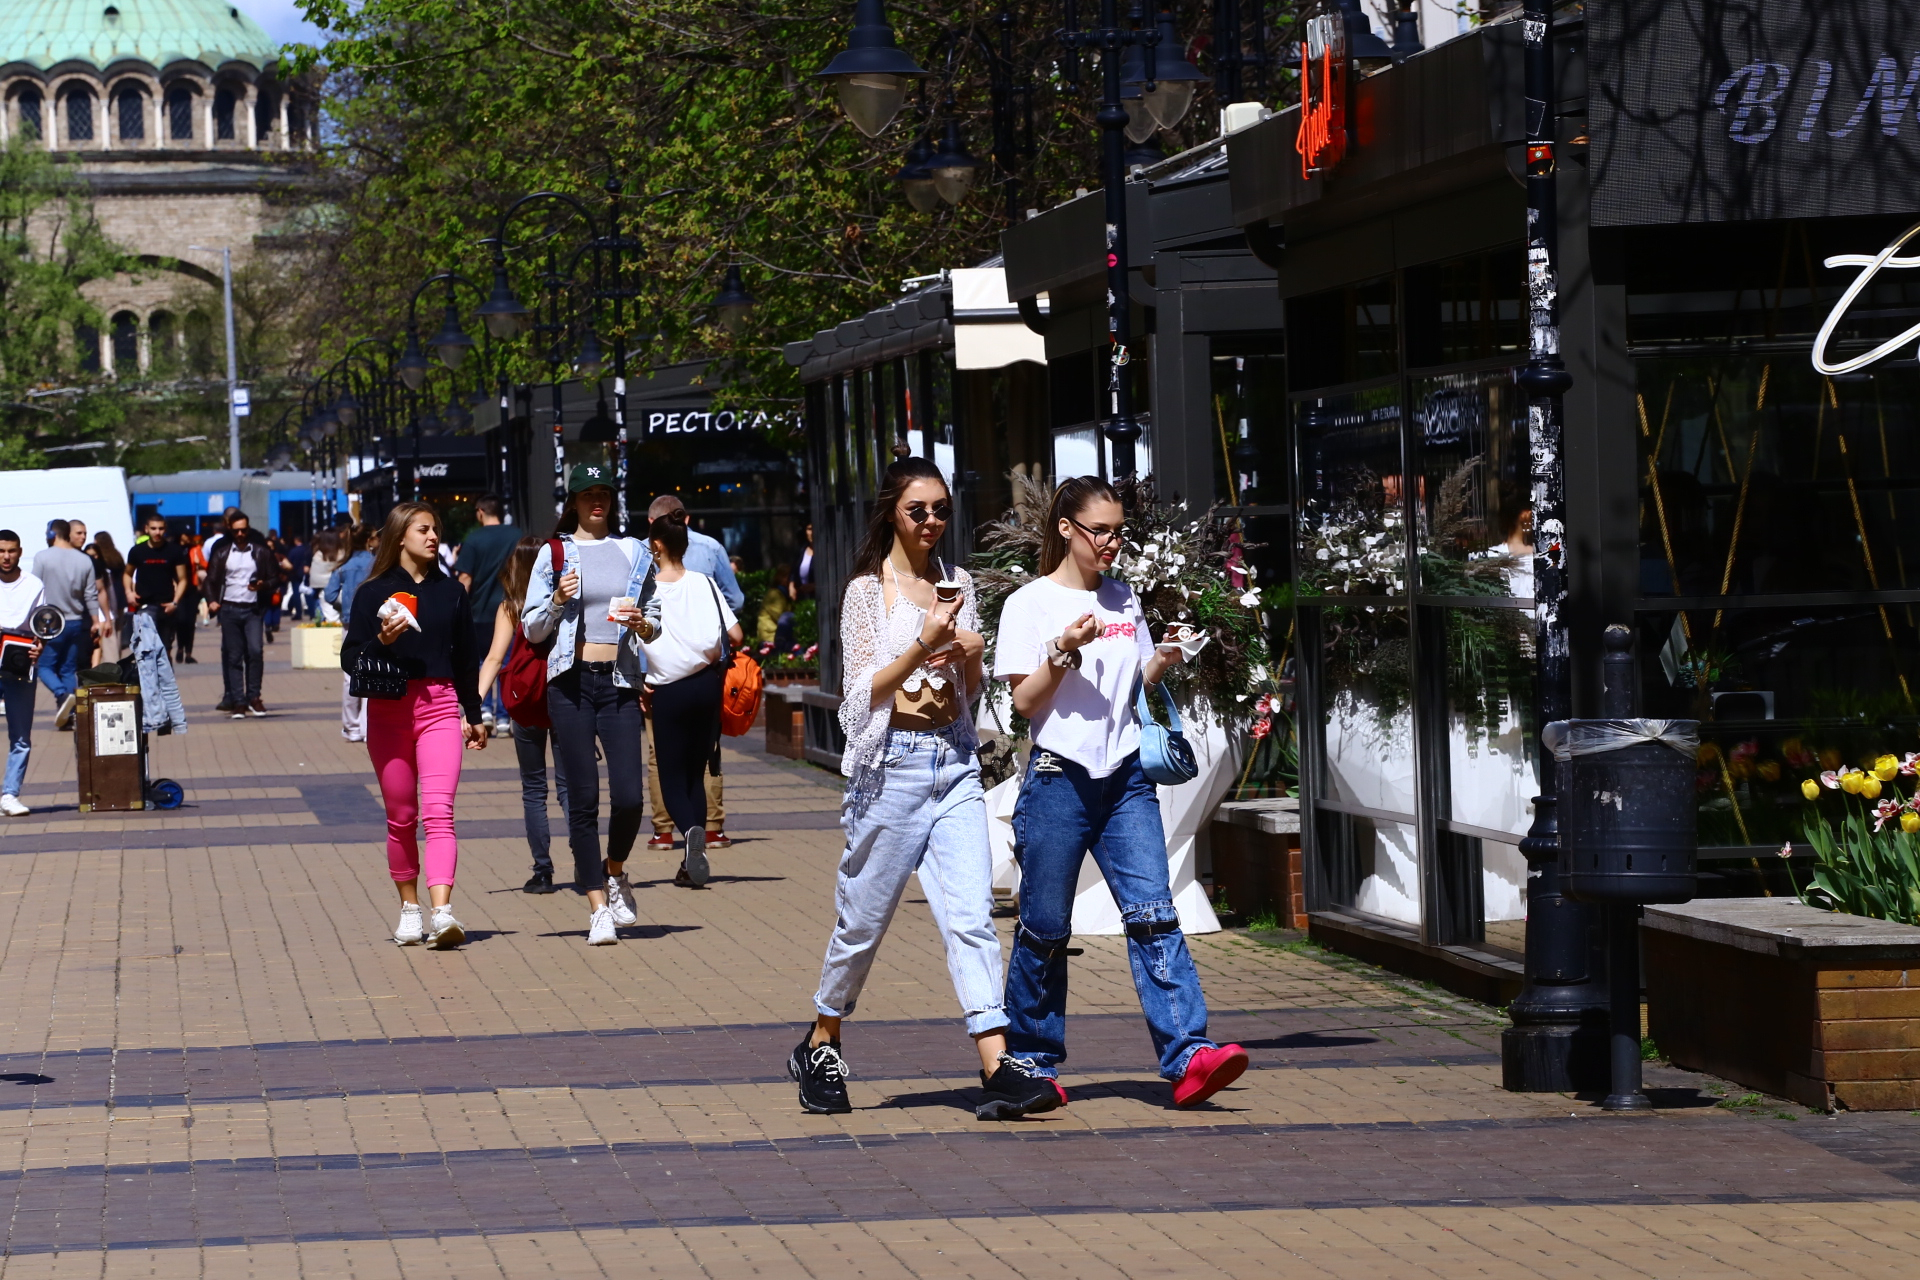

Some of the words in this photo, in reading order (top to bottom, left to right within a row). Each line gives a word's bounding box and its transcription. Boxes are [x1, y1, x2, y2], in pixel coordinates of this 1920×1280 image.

[1714, 52, 1920, 144] BIN
[649, 410, 803, 434] РЕСТОРА
[586, 467, 601, 478] NY
